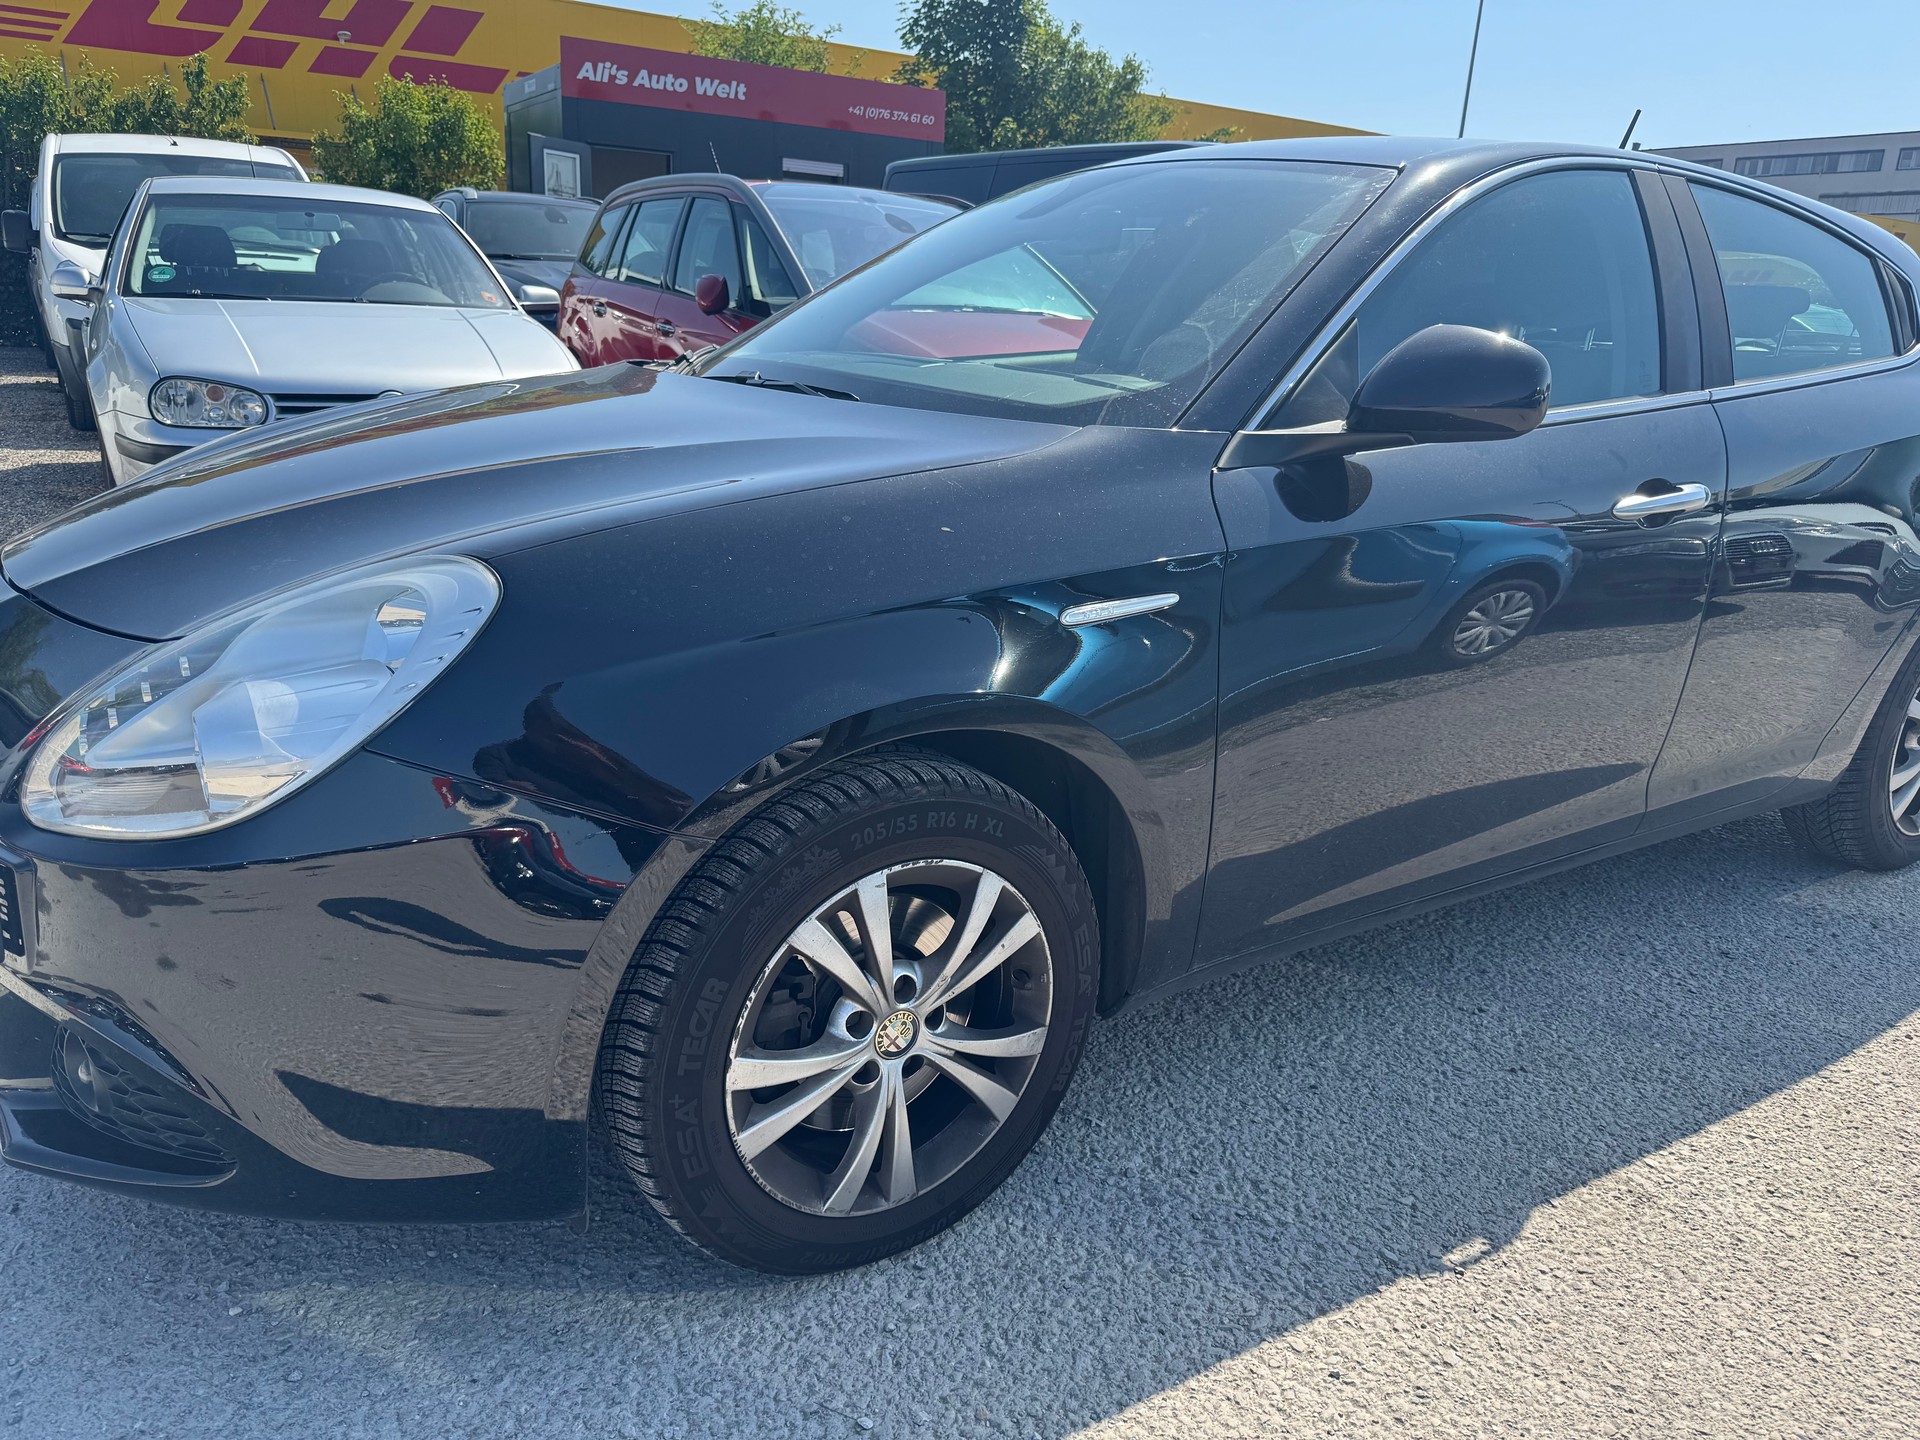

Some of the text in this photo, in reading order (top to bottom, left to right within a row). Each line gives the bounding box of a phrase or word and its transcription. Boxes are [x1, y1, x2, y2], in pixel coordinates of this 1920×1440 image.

[61, 0, 509, 94] DHL
[632, 69, 689, 93] Auto
[694, 76, 747, 101] Welt
[848, 106, 935, 125] +41 (0)76 374 61 60
[850, 811, 1006, 851] 205/55 R16 H XL
[677, 976, 728, 1077] TECAR
[885, 1013, 914, 1027] ROMEO
